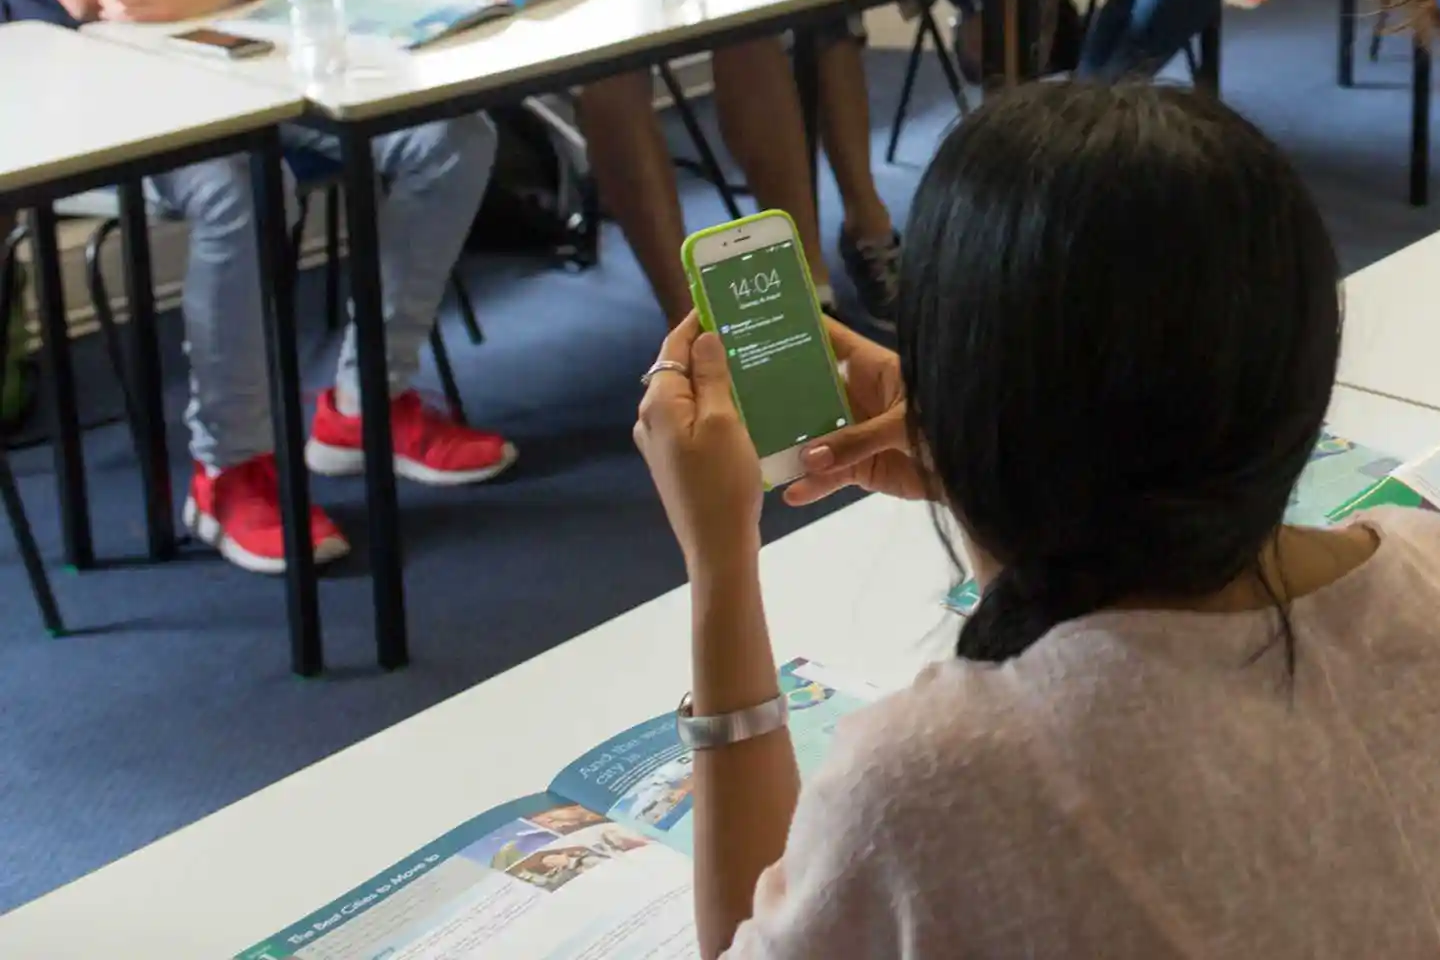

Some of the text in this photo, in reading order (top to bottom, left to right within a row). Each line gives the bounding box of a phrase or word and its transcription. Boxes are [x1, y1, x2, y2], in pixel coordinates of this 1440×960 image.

[729, 268, 781, 301] 14:04
[580, 752, 613, 780] And
[596, 762, 625, 786] city
[287, 853, 440, 945] The Best Cities to Move to
